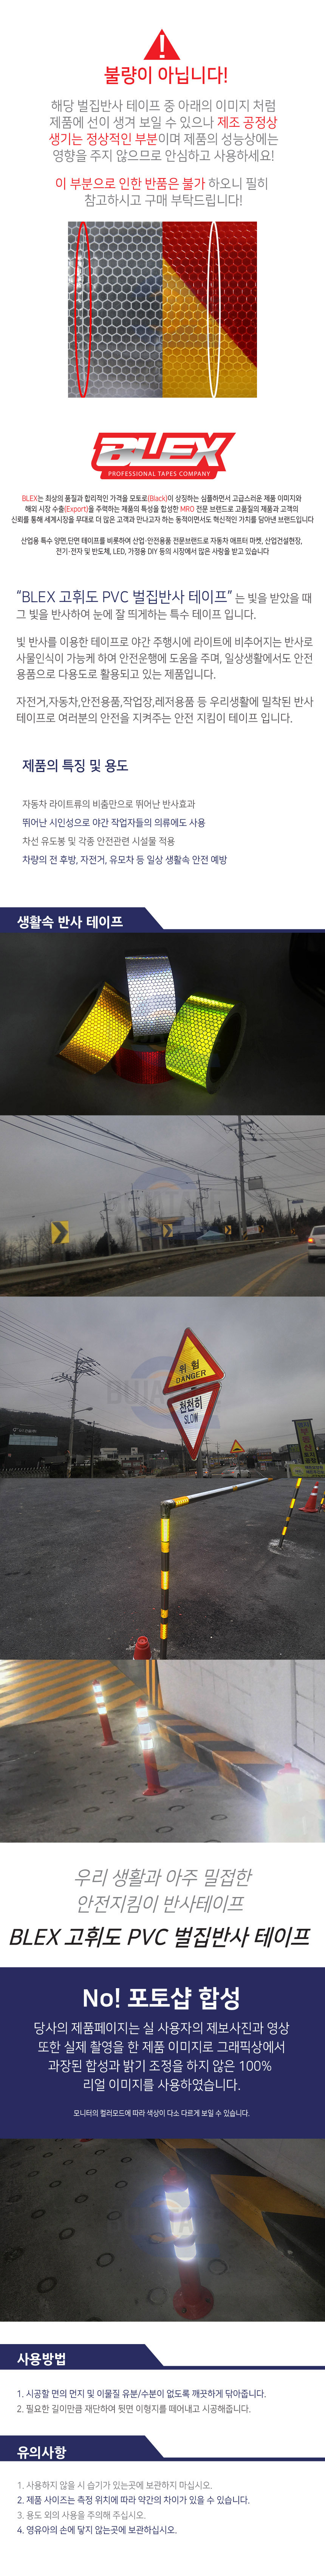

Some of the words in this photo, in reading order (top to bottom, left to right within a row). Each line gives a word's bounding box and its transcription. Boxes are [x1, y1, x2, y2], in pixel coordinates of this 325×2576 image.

[176, 1370, 206, 1384] DANGER
[180, 1396, 202, 1414] 천천히
[184, 1413, 198, 1424] SLOW
[300, 1428, 313, 1451] 부동산
